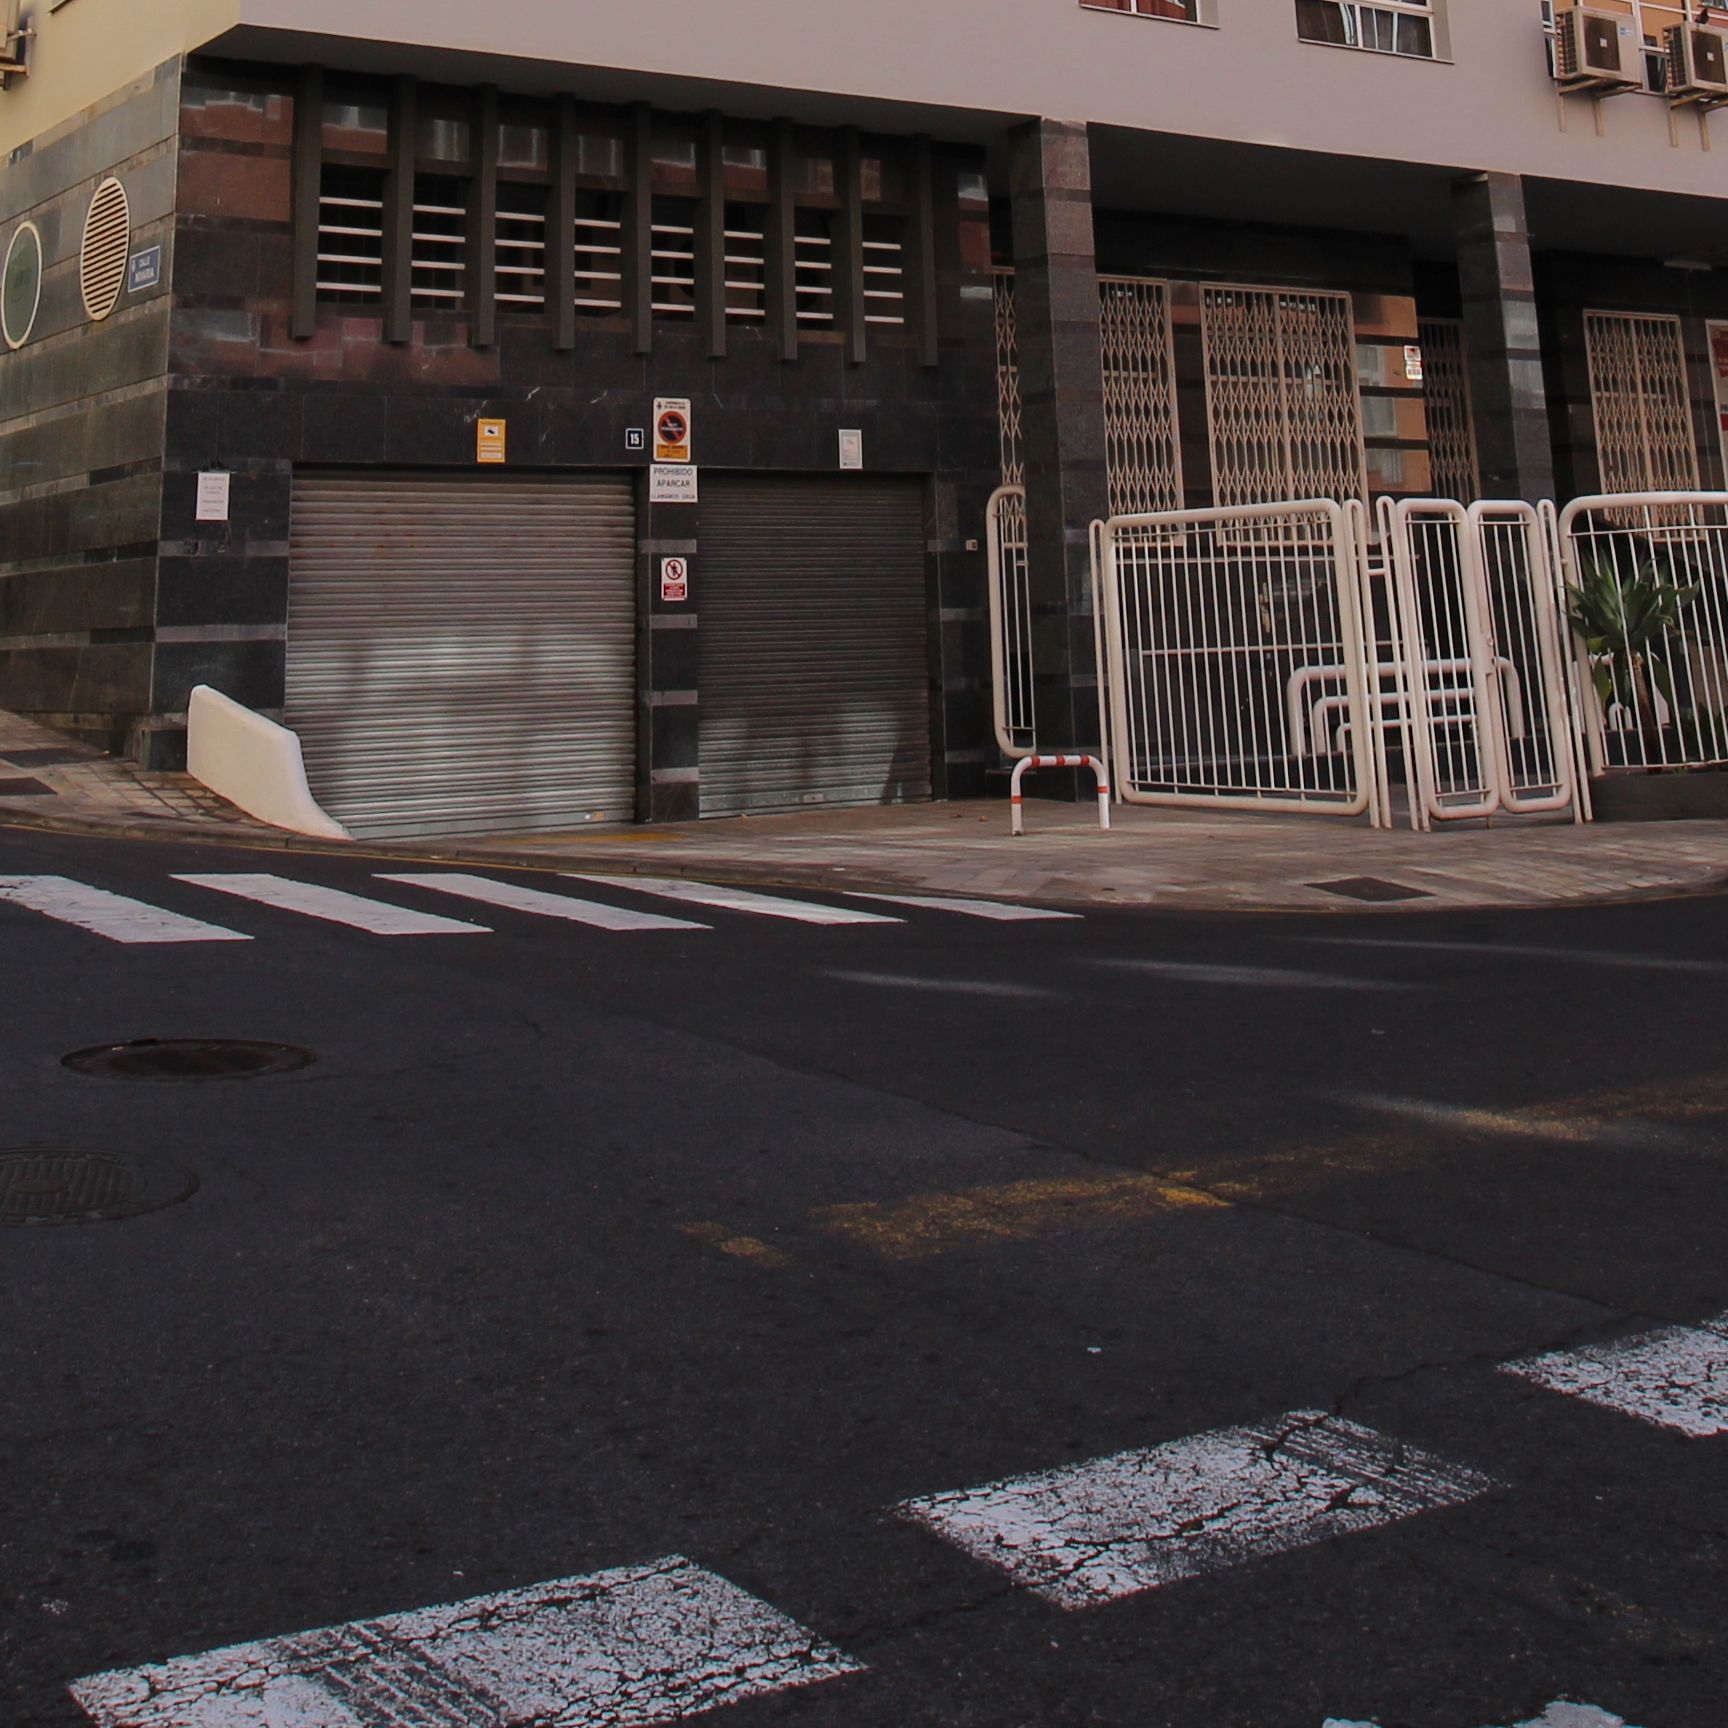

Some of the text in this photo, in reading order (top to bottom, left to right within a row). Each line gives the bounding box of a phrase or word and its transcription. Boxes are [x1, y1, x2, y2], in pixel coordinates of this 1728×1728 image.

[630, 433, 640, 445] 15
[653, 466, 693, 476] PROHIBIDO
[656, 479, 691, 487] APARCAR
